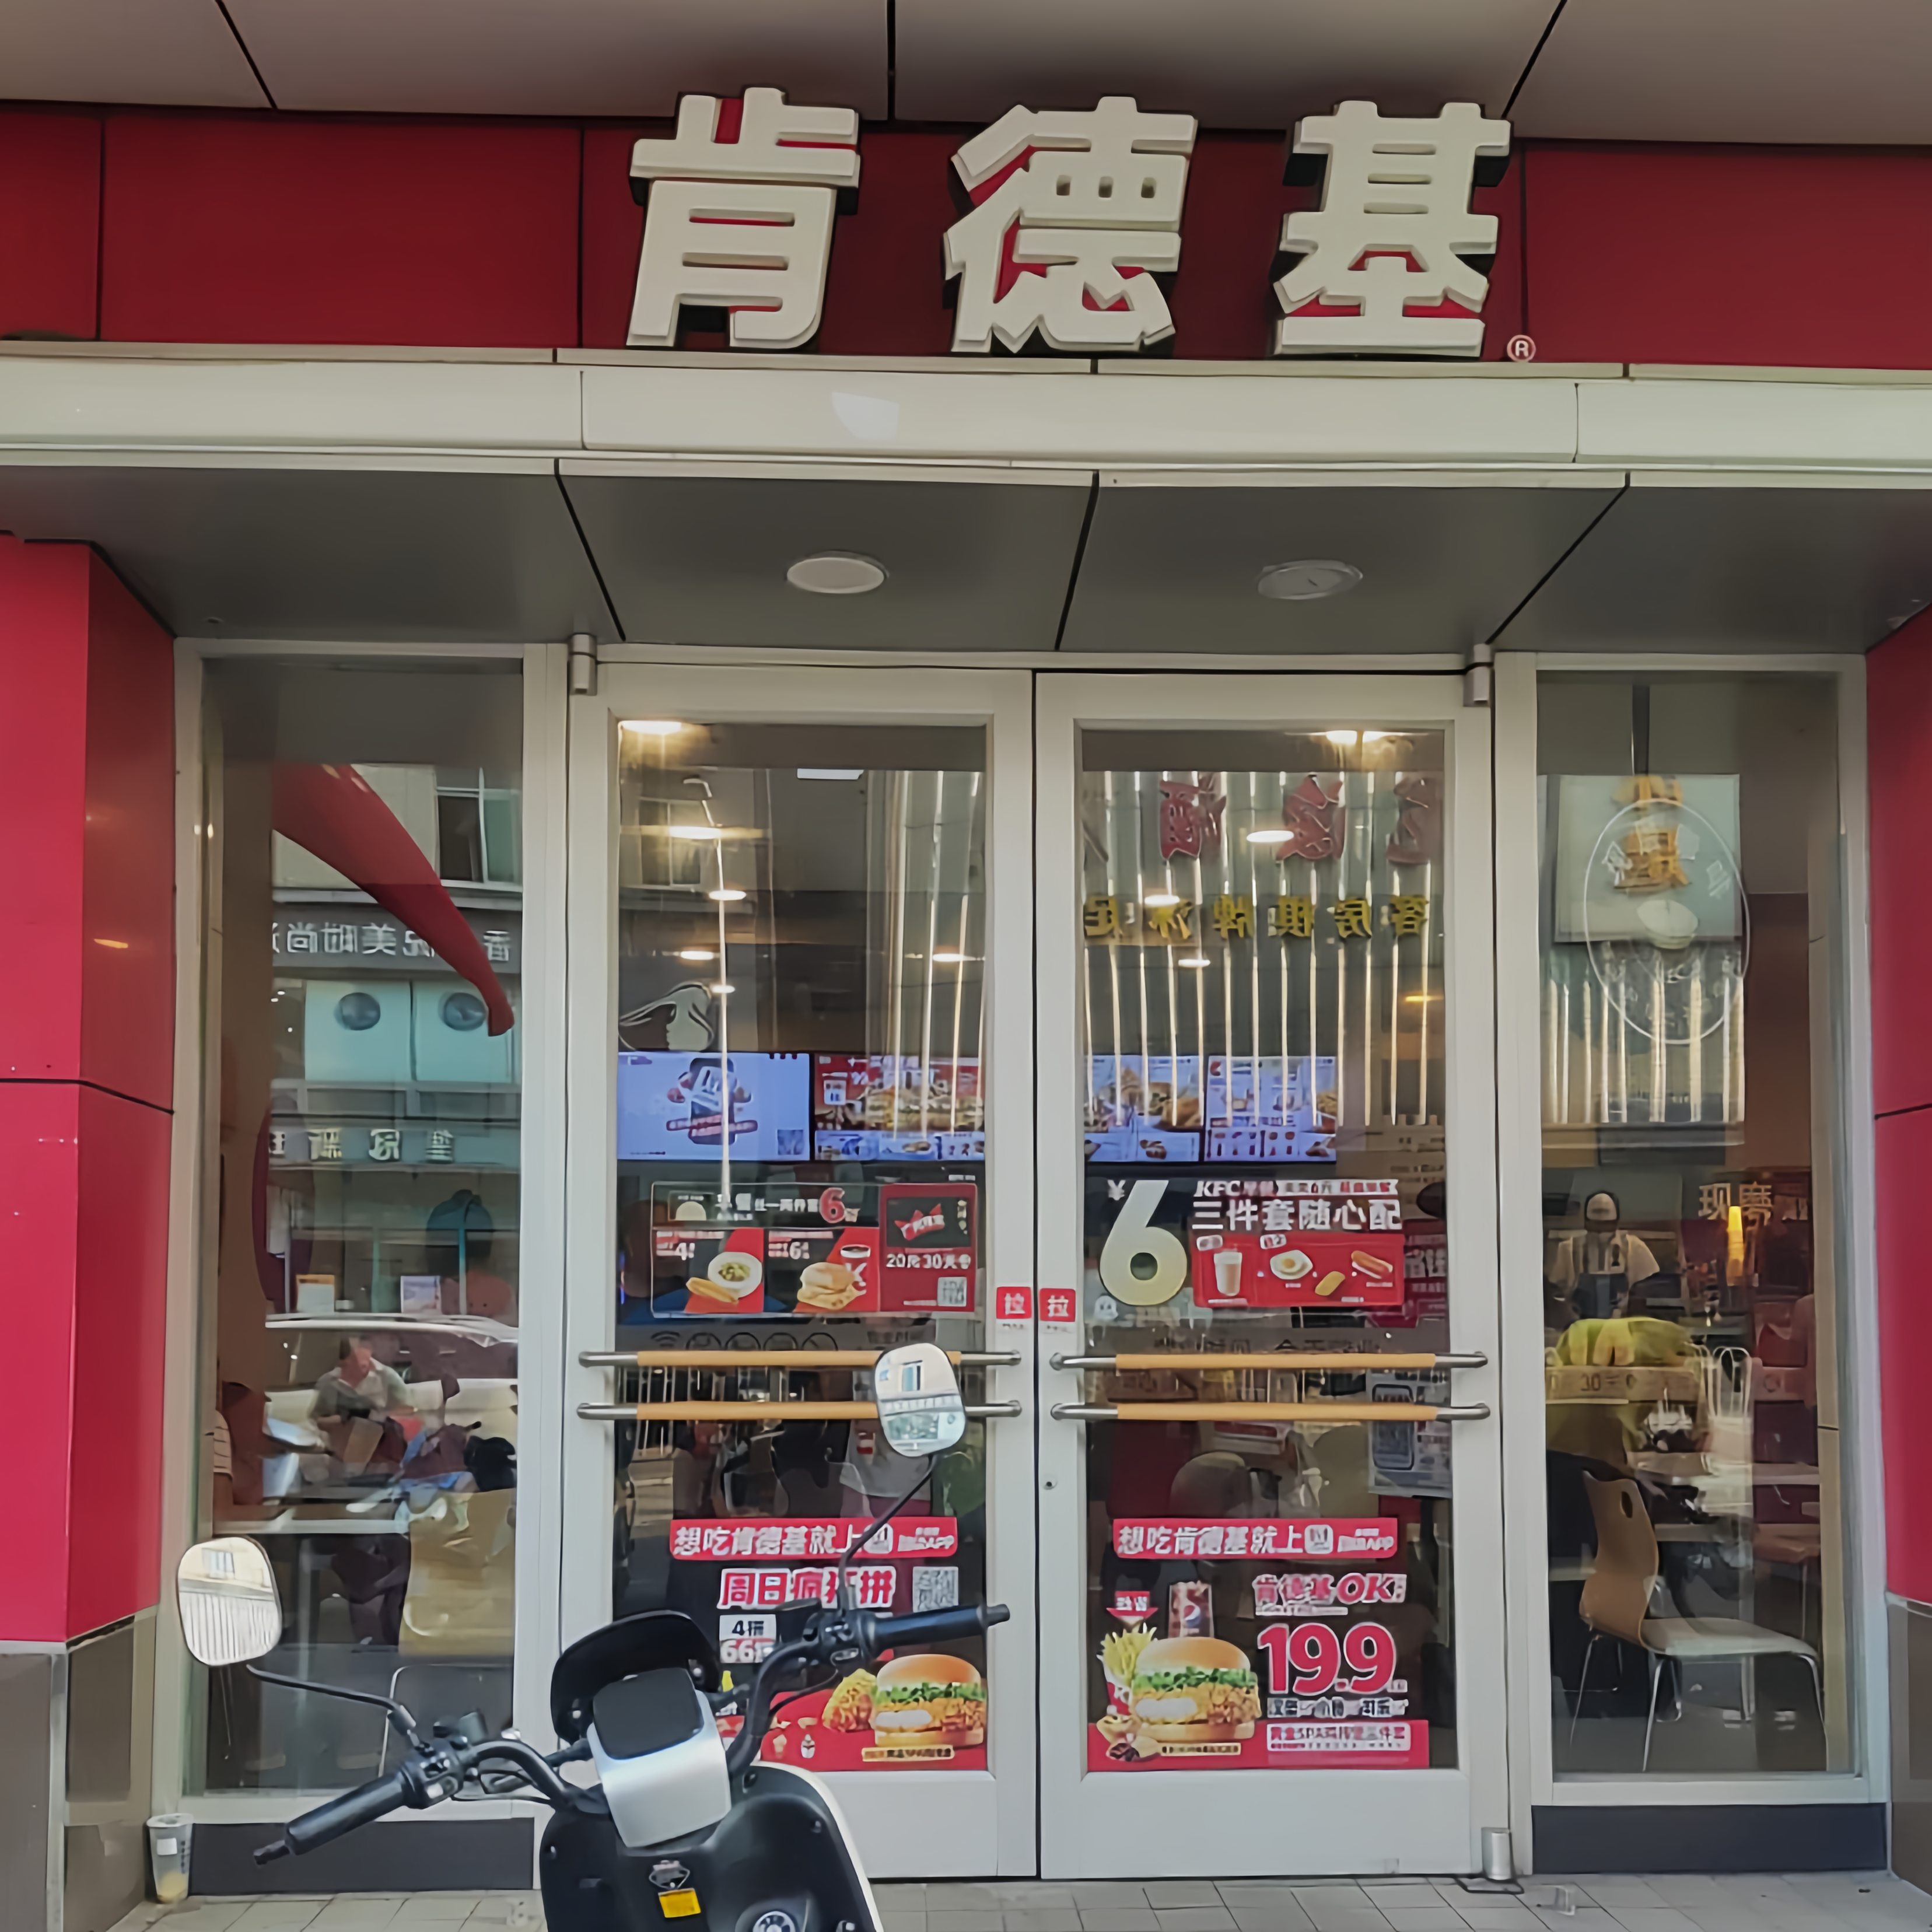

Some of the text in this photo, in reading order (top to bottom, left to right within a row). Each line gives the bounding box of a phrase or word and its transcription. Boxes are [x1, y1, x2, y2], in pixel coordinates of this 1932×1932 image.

[626, 86, 1511, 358] 肯德基
[1192, 1199, 1401, 1231] 三件套随心配
[1118, 1525, 1303, 1555] 想吃肯德基就上
[1257, 1622, 1396, 1696] 19.9
